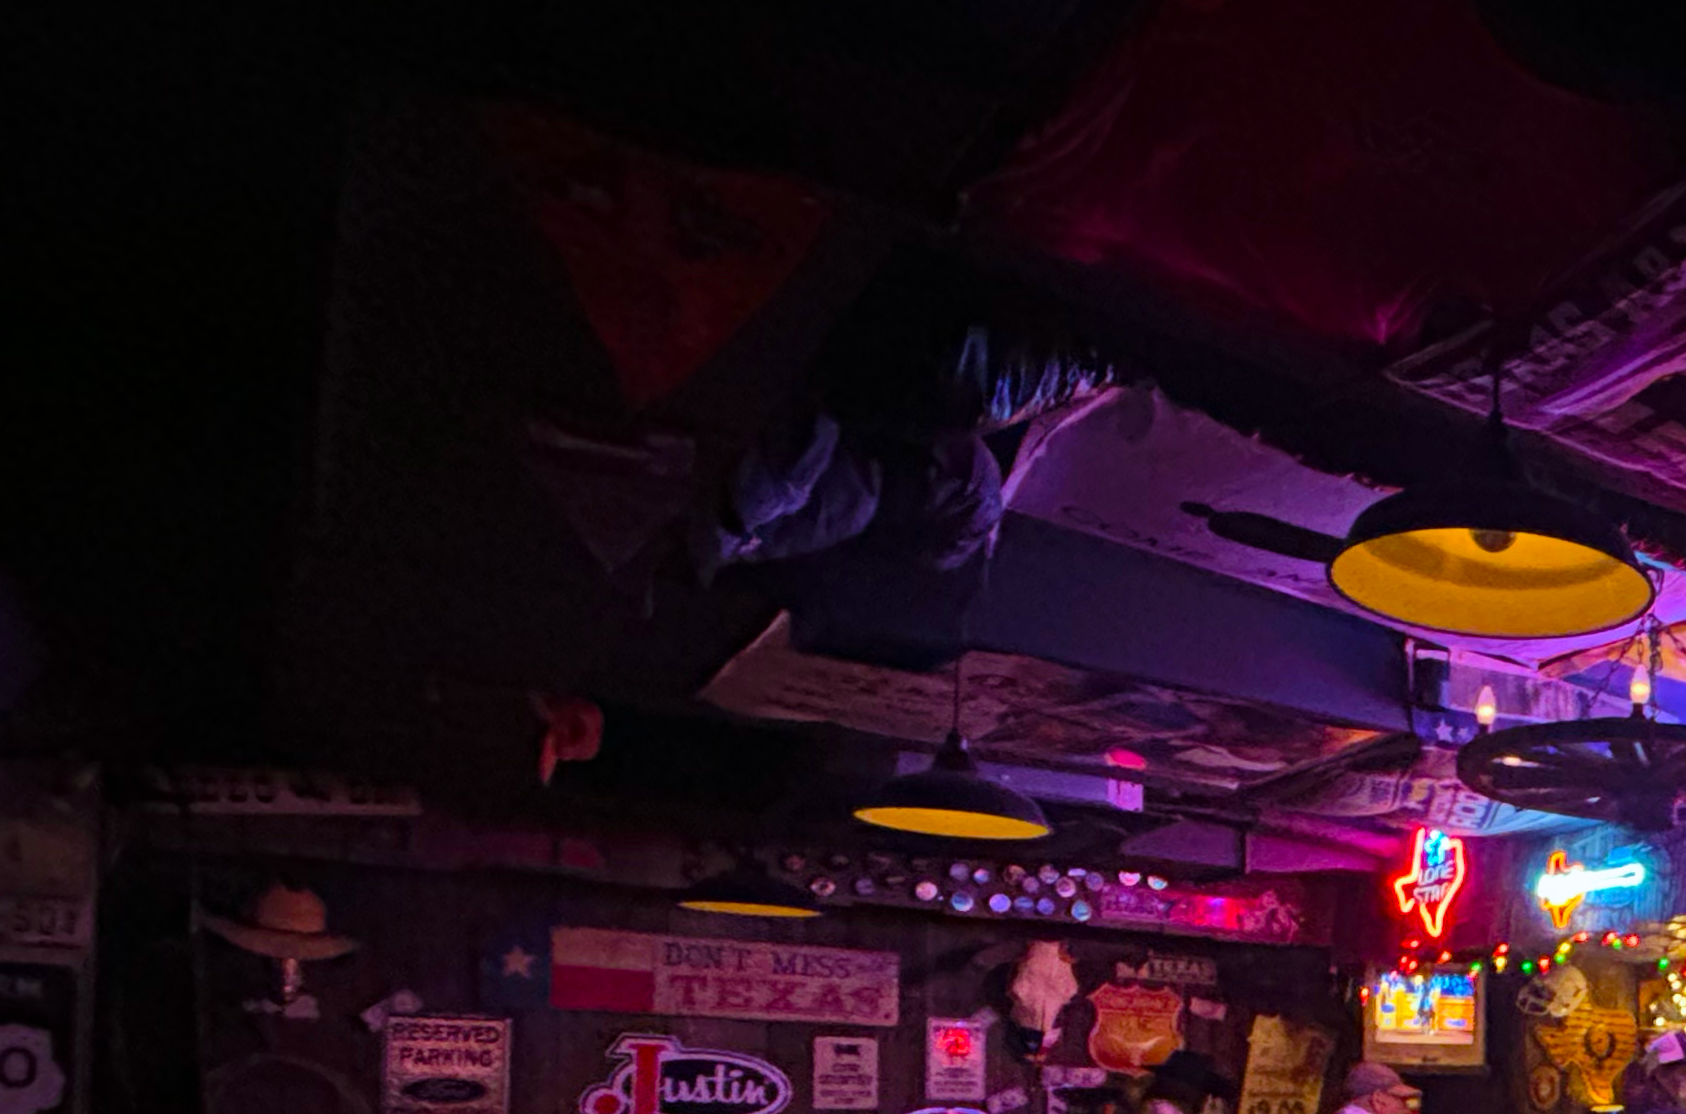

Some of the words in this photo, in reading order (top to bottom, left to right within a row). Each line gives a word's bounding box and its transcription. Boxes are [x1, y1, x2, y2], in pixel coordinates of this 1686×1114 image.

[772, 952, 850, 979] MESS
[670, 975, 882, 1014] TEXAS
[391, 1022, 500, 1044] RESERVED
[400, 1047, 494, 1067] PARKING
